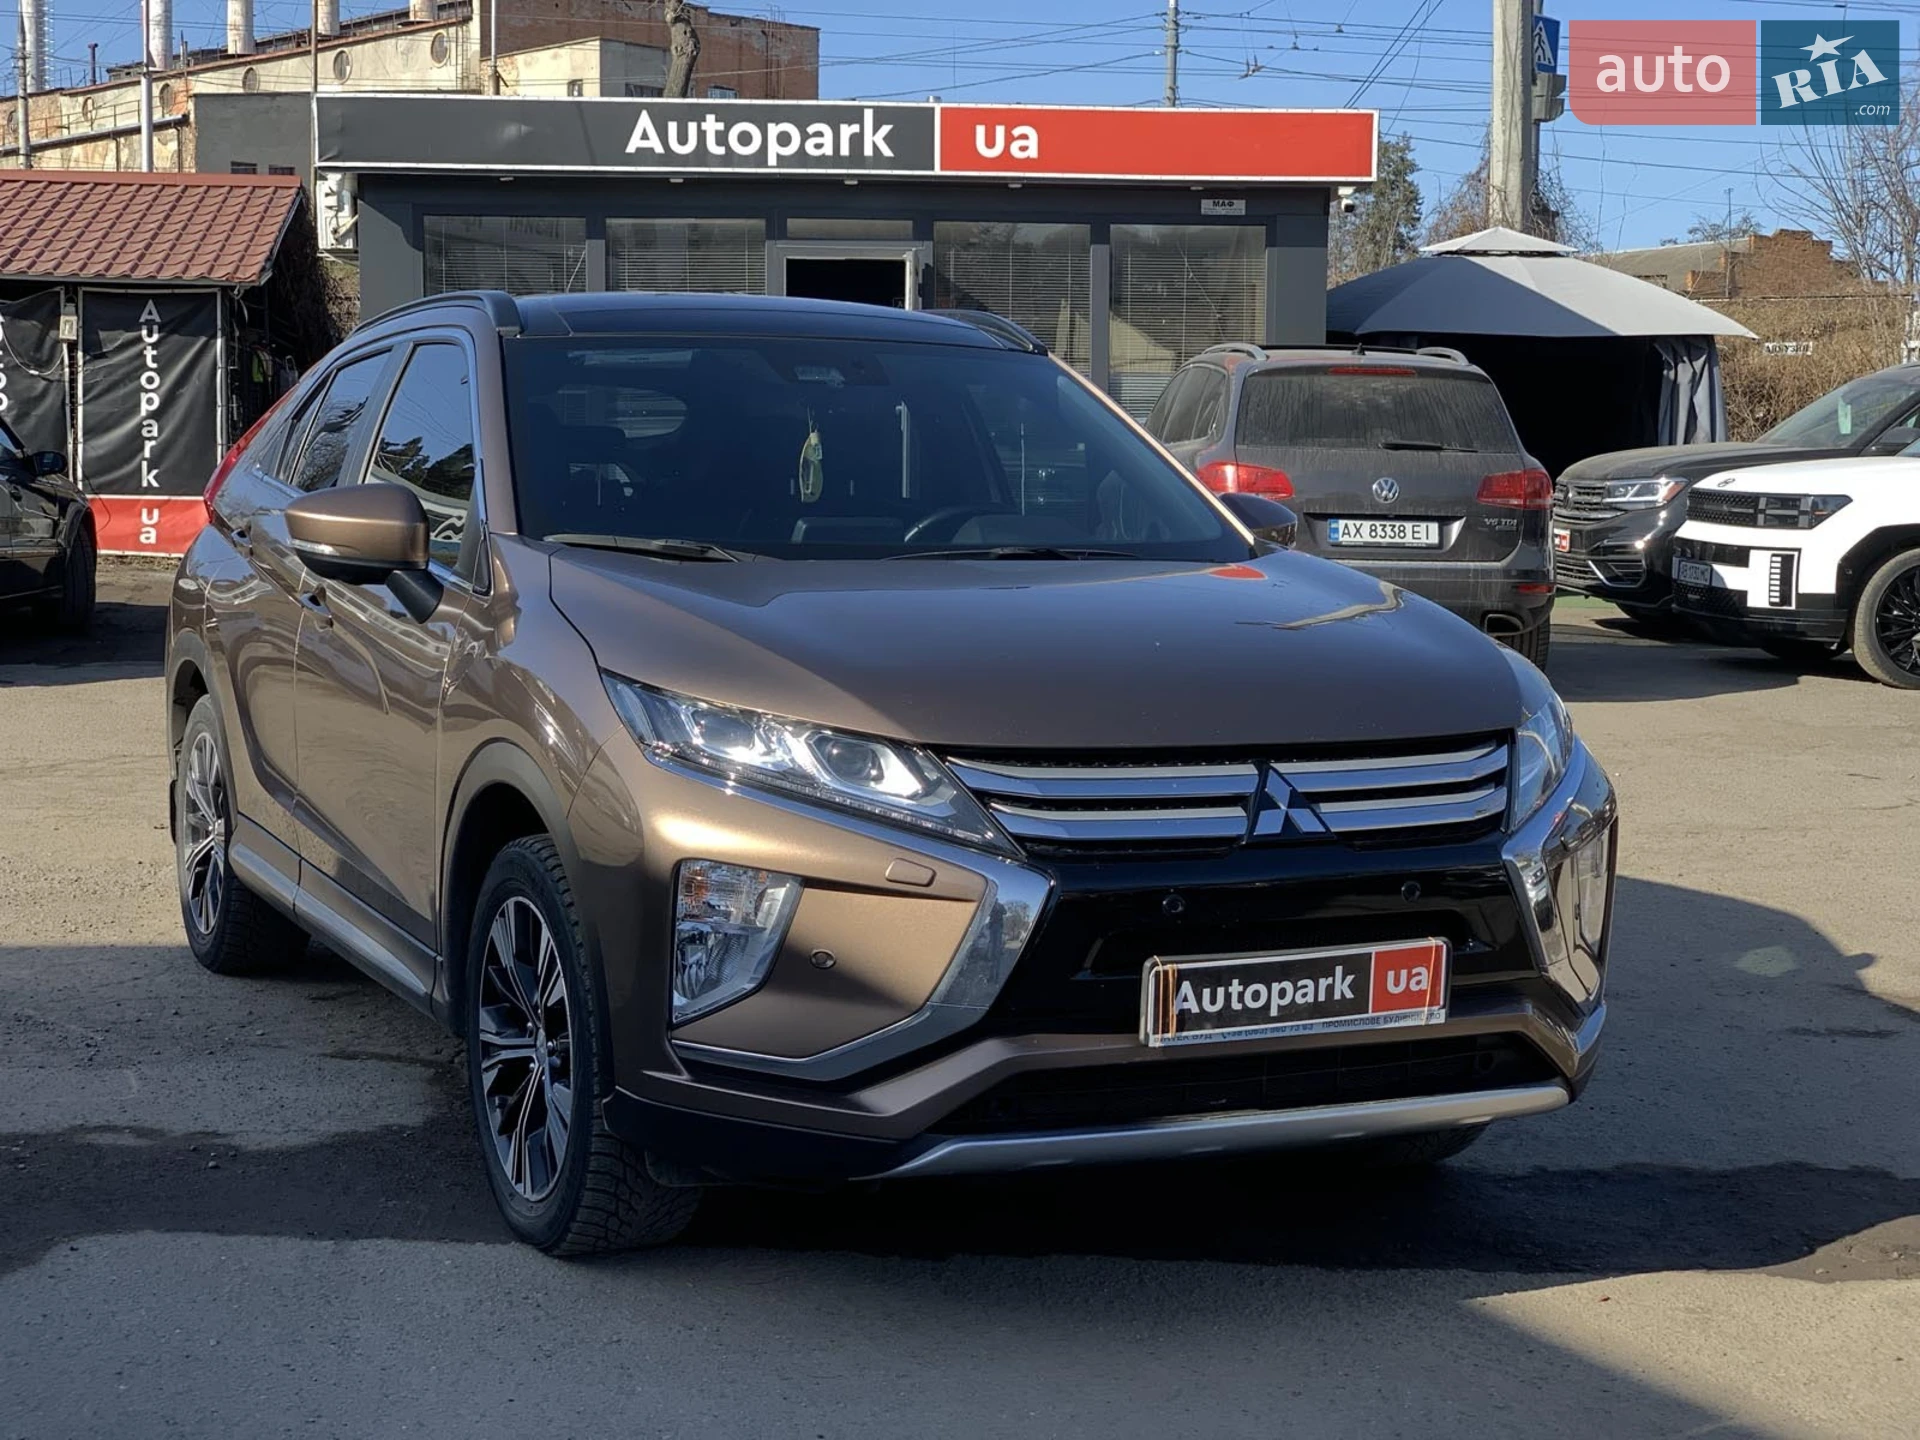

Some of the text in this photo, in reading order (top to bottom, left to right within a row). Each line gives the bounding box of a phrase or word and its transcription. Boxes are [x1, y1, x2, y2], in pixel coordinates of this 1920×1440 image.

[625, 108, 1039, 167] Autopark ua
[1212, 200, 1235, 208] МАФ
[139, 299, 161, 488] Autopark
[139, 508, 160, 545] ua
[1341, 523, 1430, 540] AX 8338 EI
[1175, 964, 1430, 1017] Autopark ua
